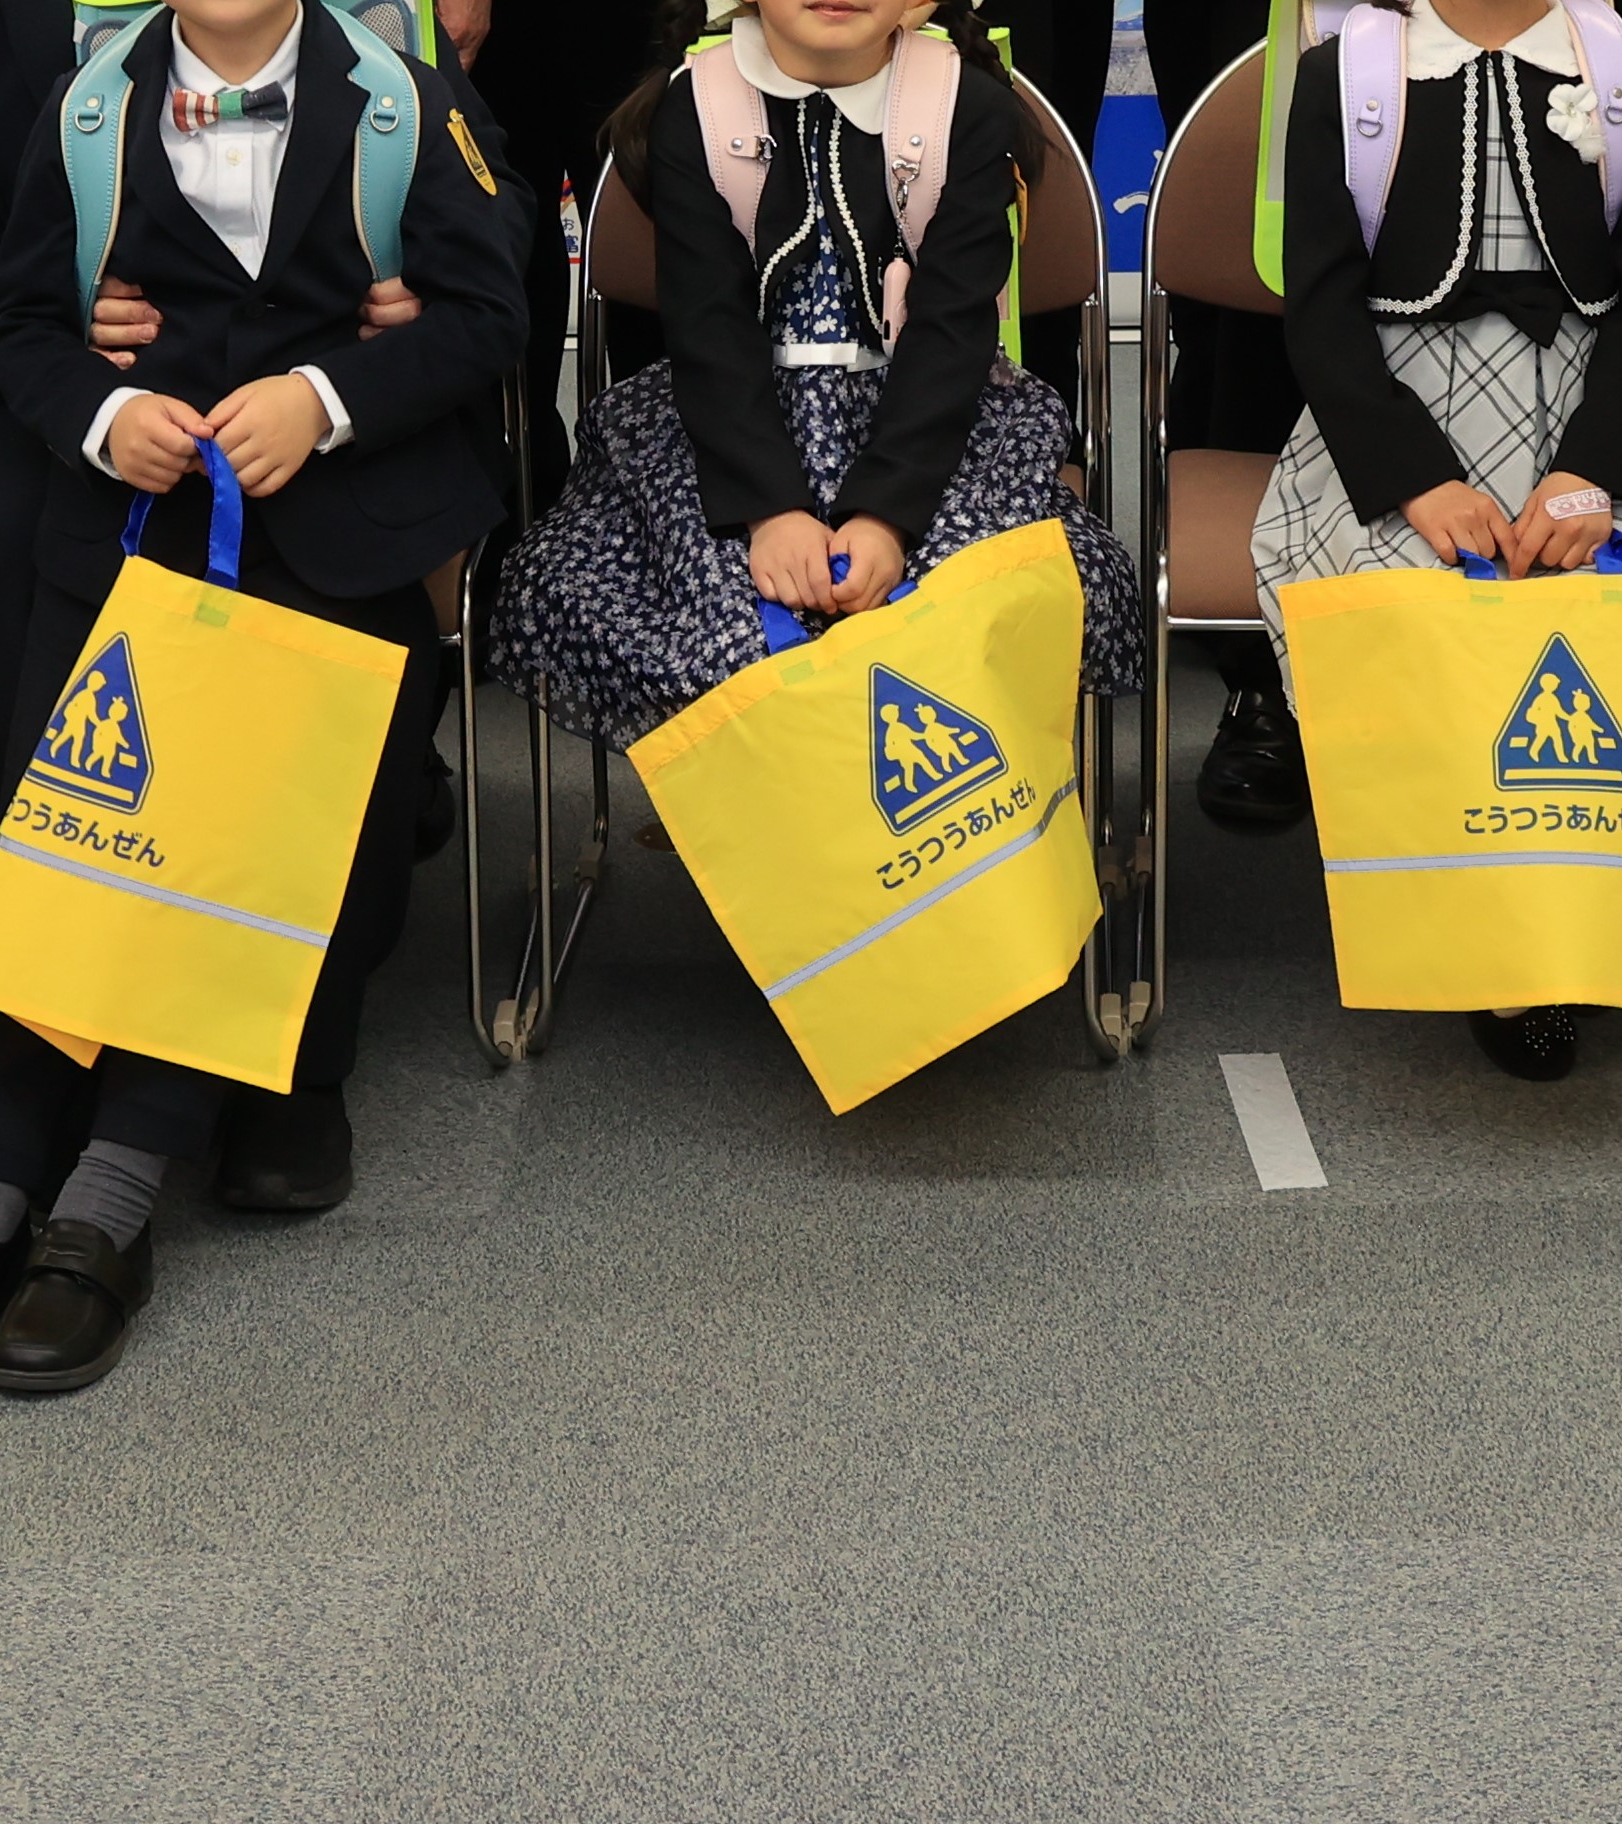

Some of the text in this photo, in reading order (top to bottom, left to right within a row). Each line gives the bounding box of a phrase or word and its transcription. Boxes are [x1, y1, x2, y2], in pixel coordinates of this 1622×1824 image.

[6, 797, 165, 868] つうあんぜん
[876, 777, 1036, 890] こうつうあんぜん
